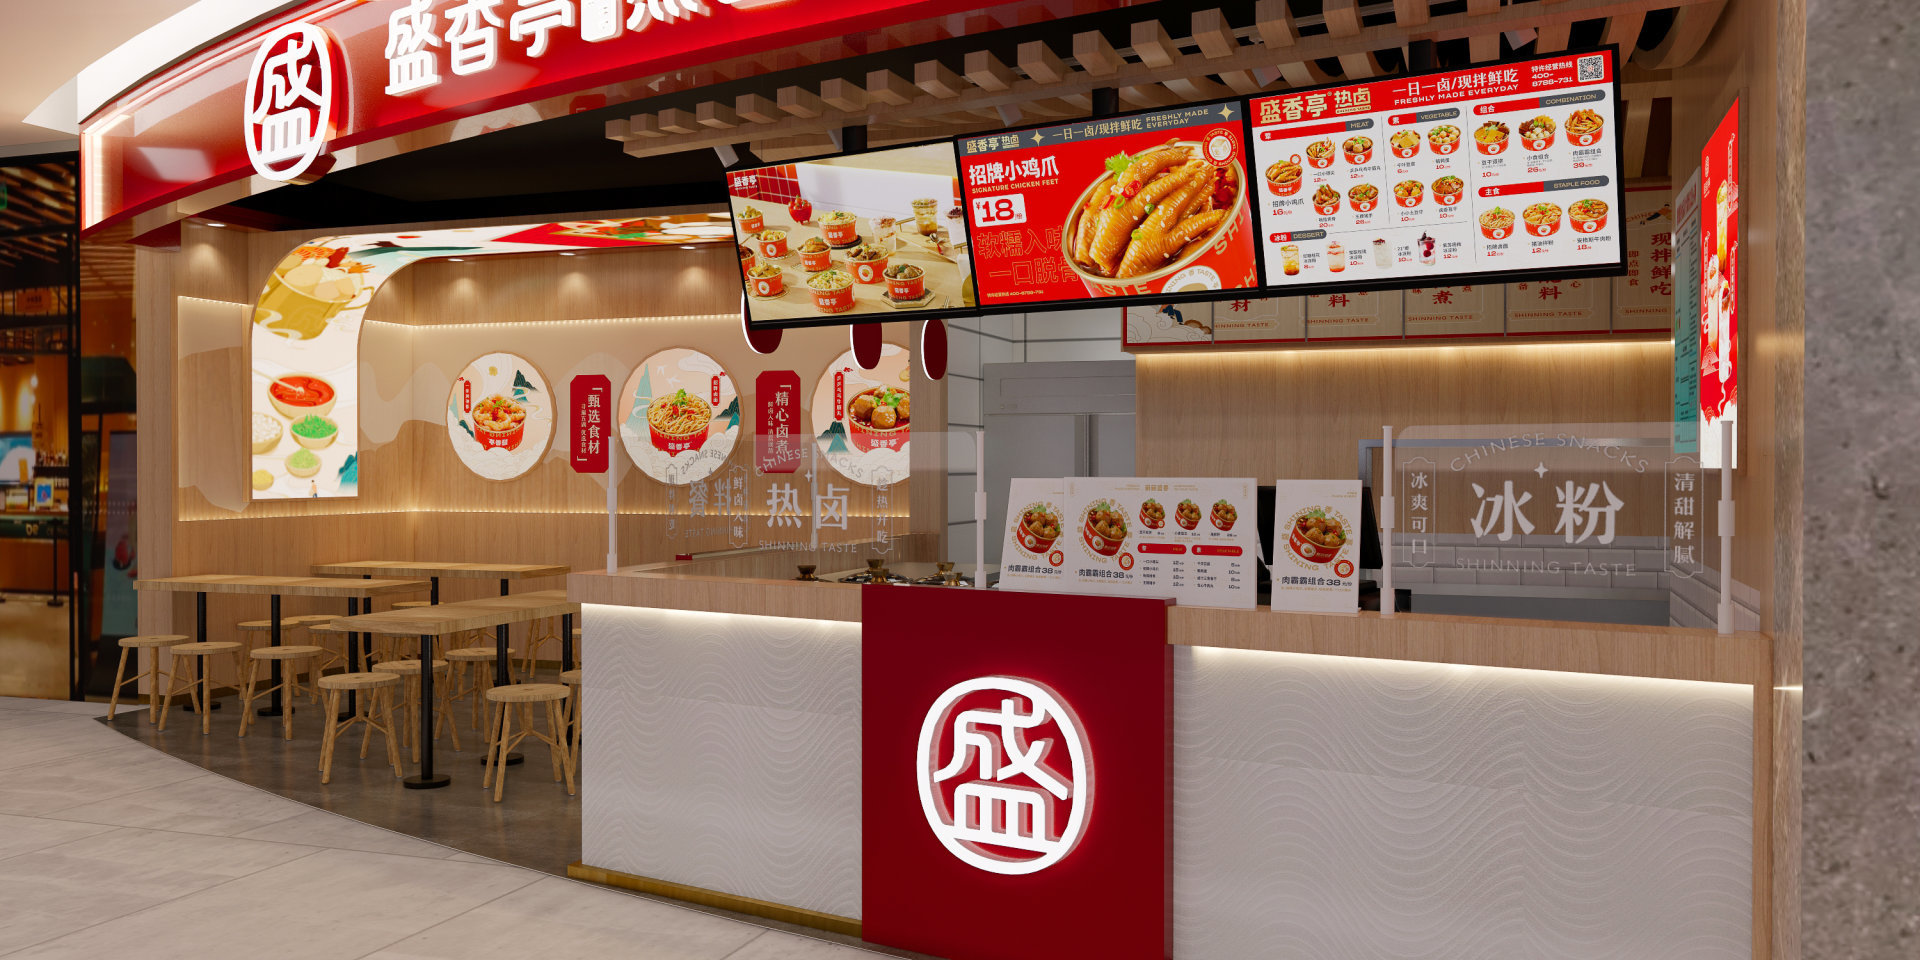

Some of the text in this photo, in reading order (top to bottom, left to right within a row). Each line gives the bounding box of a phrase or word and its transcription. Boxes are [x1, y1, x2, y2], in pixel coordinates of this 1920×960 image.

[1392, 68, 1519, 97] 一日一卤/现拌鲜吃
[1394, 84, 1519, 105] FRESHLY MADE EVERYDAY
[1545, 94, 1597, 105] COMBINATION
[1145, 108, 1209, 123] FRESHLY MADE
[1420, 110, 1458, 120] VEGETABLE
[1479, 104, 1495, 114] 组合
[1052, 118, 1143, 139] 一日一卤/现拌鲜吃
[1146, 118, 1190, 129] EVERYDAY
[1350, 121, 1370, 129] MEAT
[968, 155, 1060, 186] 招牌小鸡爪
[971, 177, 1059, 194] SIGNATURE CHICKEN FEET
[1485, 187, 1500, 196] 主食
[1553, 179, 1601, 189] STAPLE FOOD
[1293, 230, 1324, 240] DESSERT
[1650, 232, 1671, 296] 现拌鲜吃
[1450, 432, 1649, 473] CHINESE SNACKS
[733, 477, 744, 539] 鲜卤入味
[767, 483, 850, 531] 热卤
[1411, 472, 1428, 555] 冰爽可口
[1470, 480, 1625, 545] 冰粉
[1673, 472, 1695, 565] 清甜解腻
[822, 542, 857, 553] TASTE
[1456, 558, 1636, 577] SHINNING TASTE
[917, 676, 1090, 875] 盛
